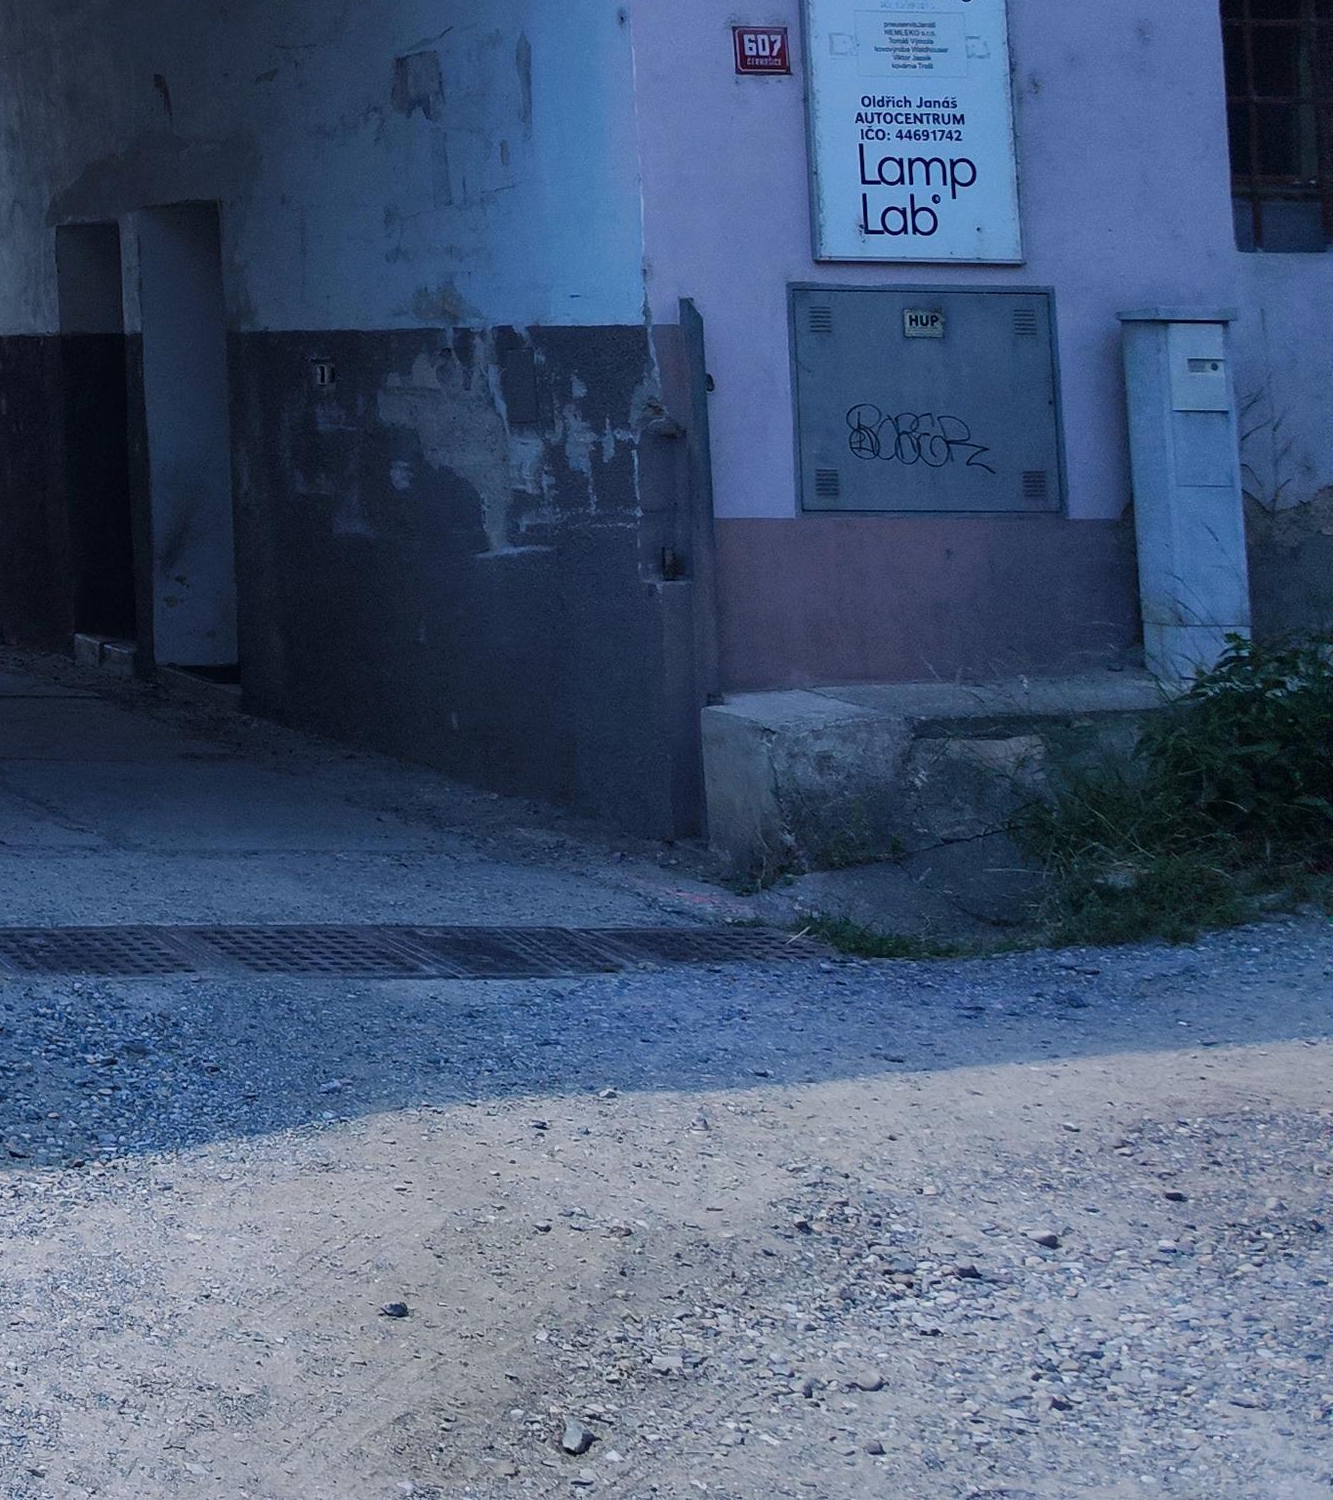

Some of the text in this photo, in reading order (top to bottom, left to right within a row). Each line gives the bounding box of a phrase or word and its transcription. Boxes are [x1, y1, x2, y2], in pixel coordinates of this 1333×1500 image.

[743, 34, 781, 56] 607
[861, 95, 957, 109] Oldřich Janáš
[855, 112, 965, 125] AUTOCENTRUM
[861, 126, 962, 141] IČO: 44691742
[858, 144, 977, 199] Lamp
[909, 315, 938, 326] HUP
